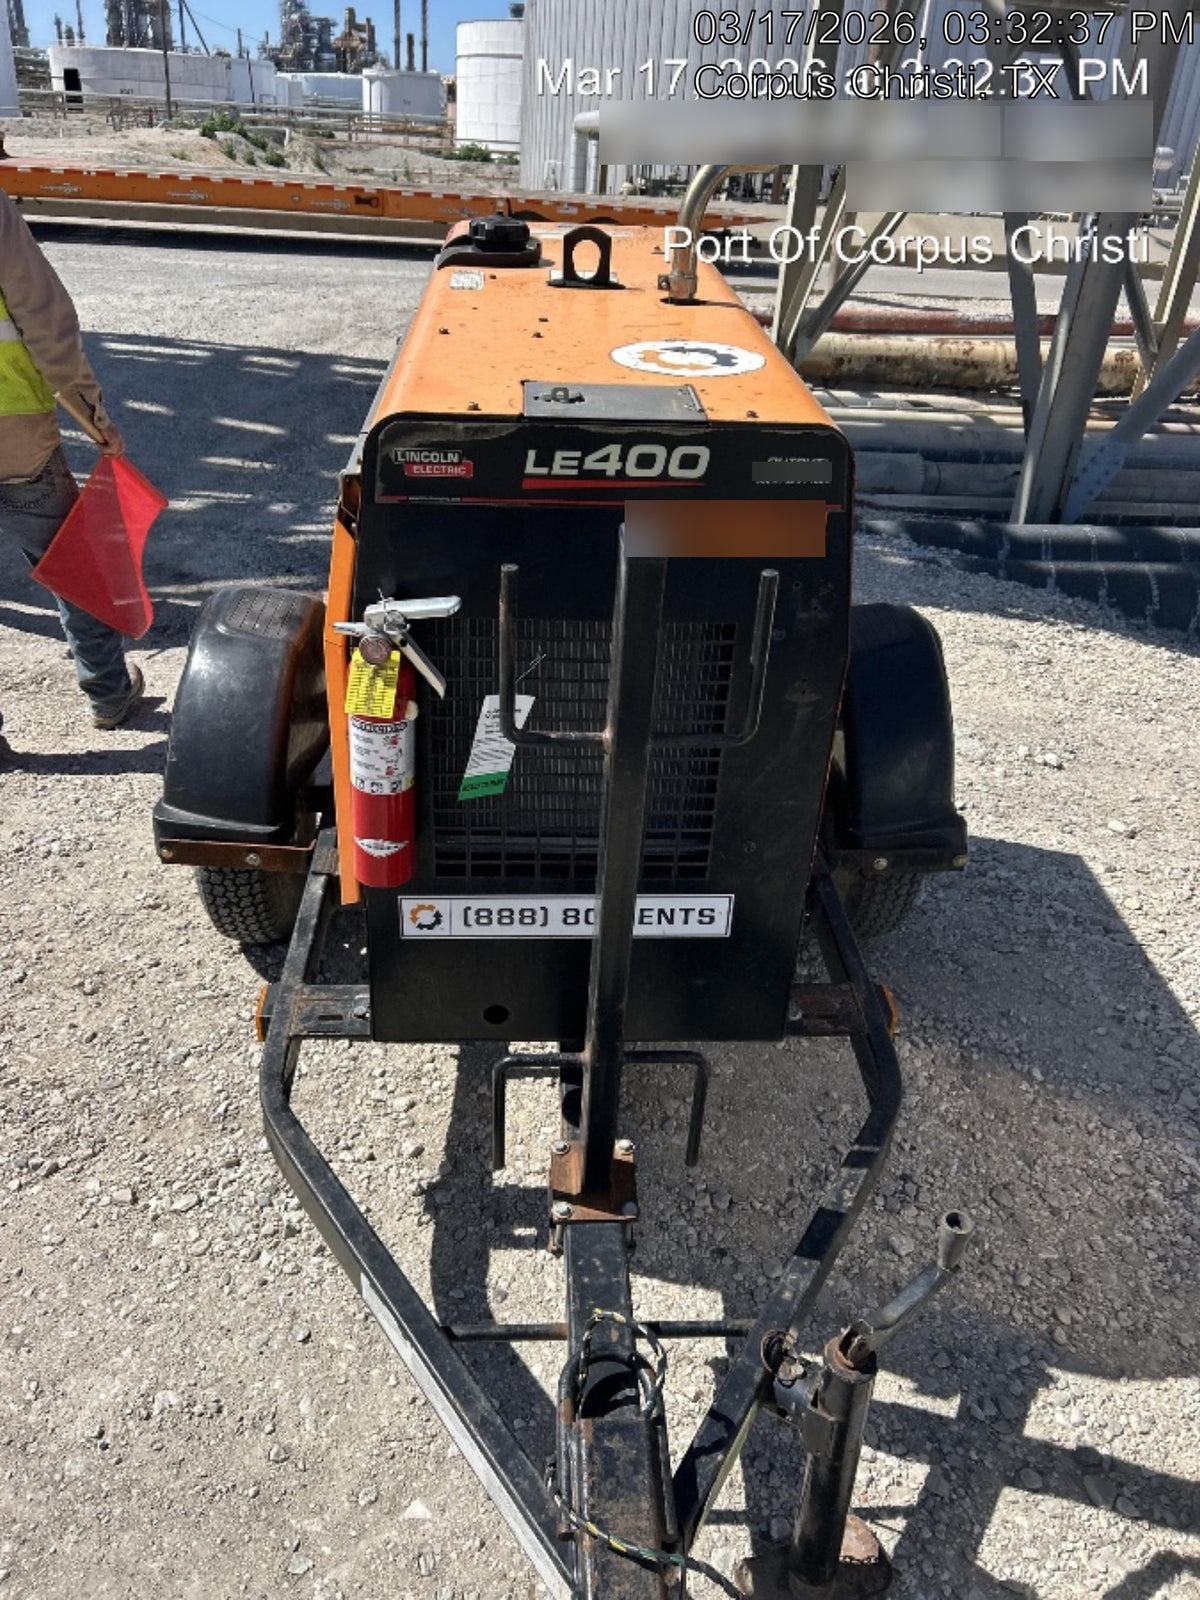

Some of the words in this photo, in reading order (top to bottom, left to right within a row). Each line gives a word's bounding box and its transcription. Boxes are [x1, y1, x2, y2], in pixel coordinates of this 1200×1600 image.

[397, 451, 459, 463] LINCOLN
[525, 443, 710, 478] LE400
[413, 464, 467, 475] ELECTRIC
[463, 906, 549, 927] (888)
